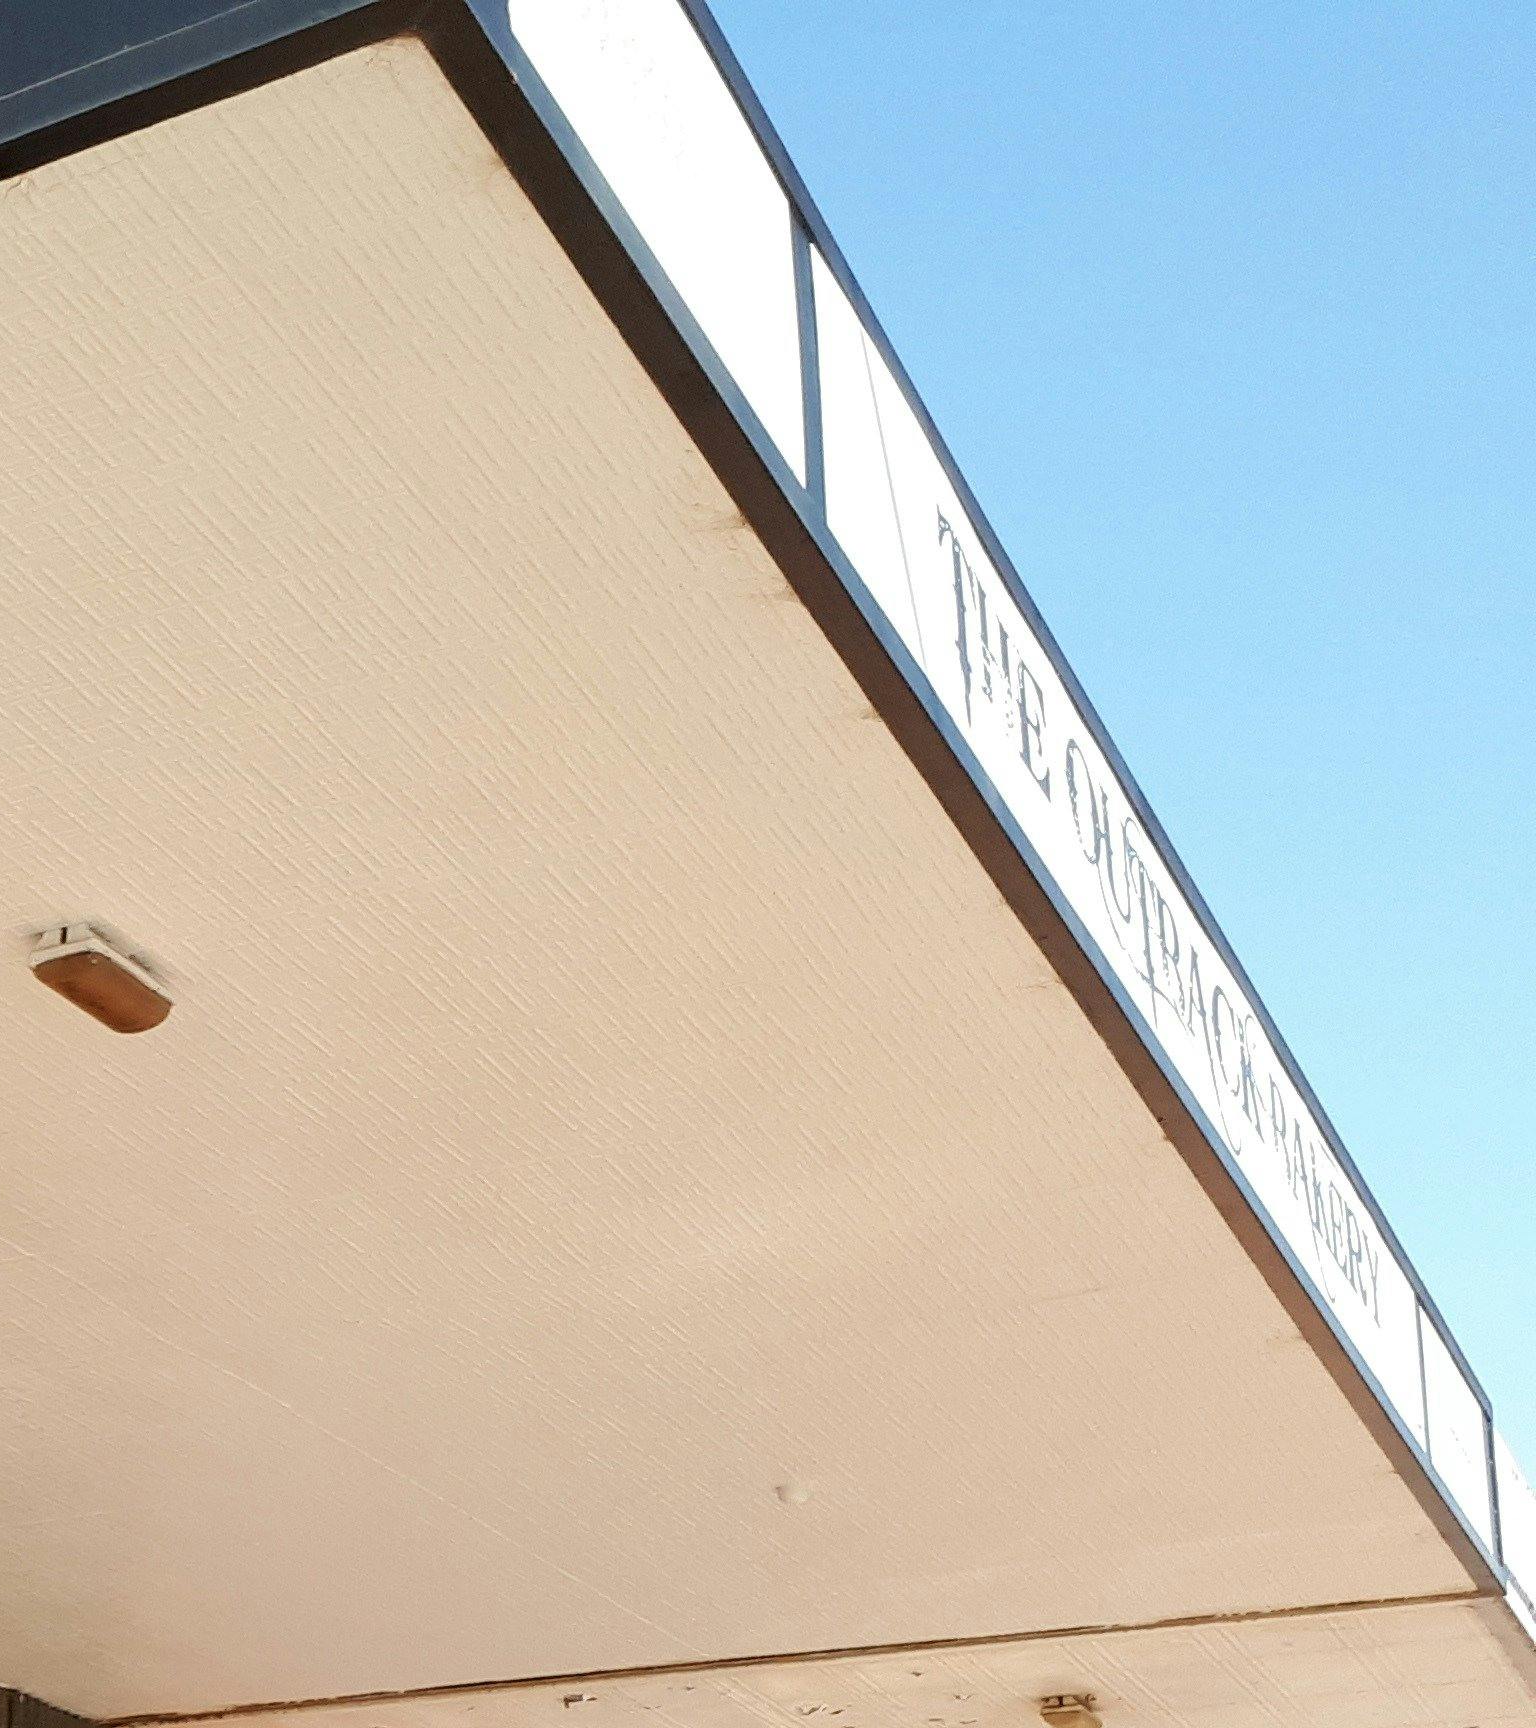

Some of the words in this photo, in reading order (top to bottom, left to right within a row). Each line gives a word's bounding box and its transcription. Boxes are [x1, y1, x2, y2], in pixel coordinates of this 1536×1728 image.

[937, 510, 1052, 803] THE
[1064, 738, 1266, 1155] OUTBACK
[1268, 1074, 1383, 1328] BAKERY
